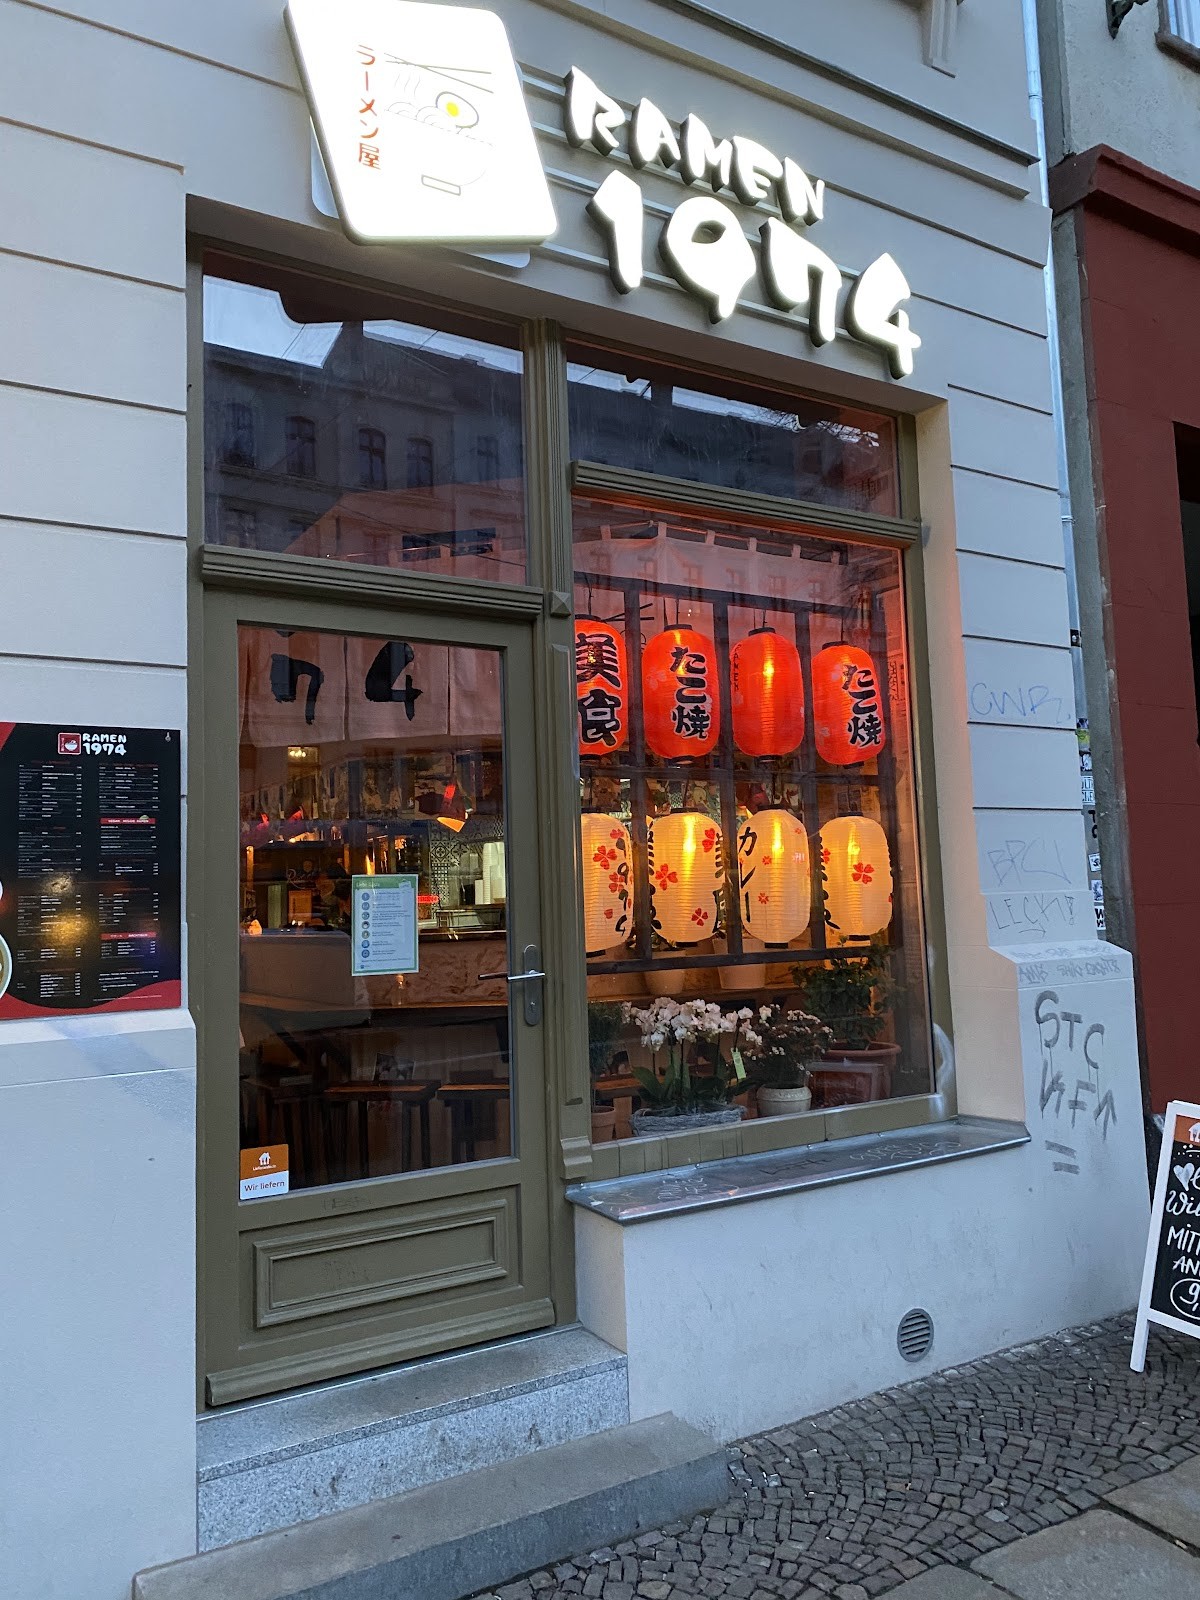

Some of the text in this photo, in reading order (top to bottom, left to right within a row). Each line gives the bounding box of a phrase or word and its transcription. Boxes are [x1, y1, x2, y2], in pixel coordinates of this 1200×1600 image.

[356, 44, 381, 170] ラーメン屋
[568, 66, 826, 224] RAMEN
[588, 169, 922, 377] 1974
[671, 647, 710, 739] たこ焼
[842, 664, 882, 748] たこ焼
[82, 733, 127, 744] RAMEN
[82, 742, 127, 756] 1974
[738, 826, 758, 924] カレー
[244, 1181, 285, 1192] Wir liefern
[1172, 1255, 1200, 1277] AN
